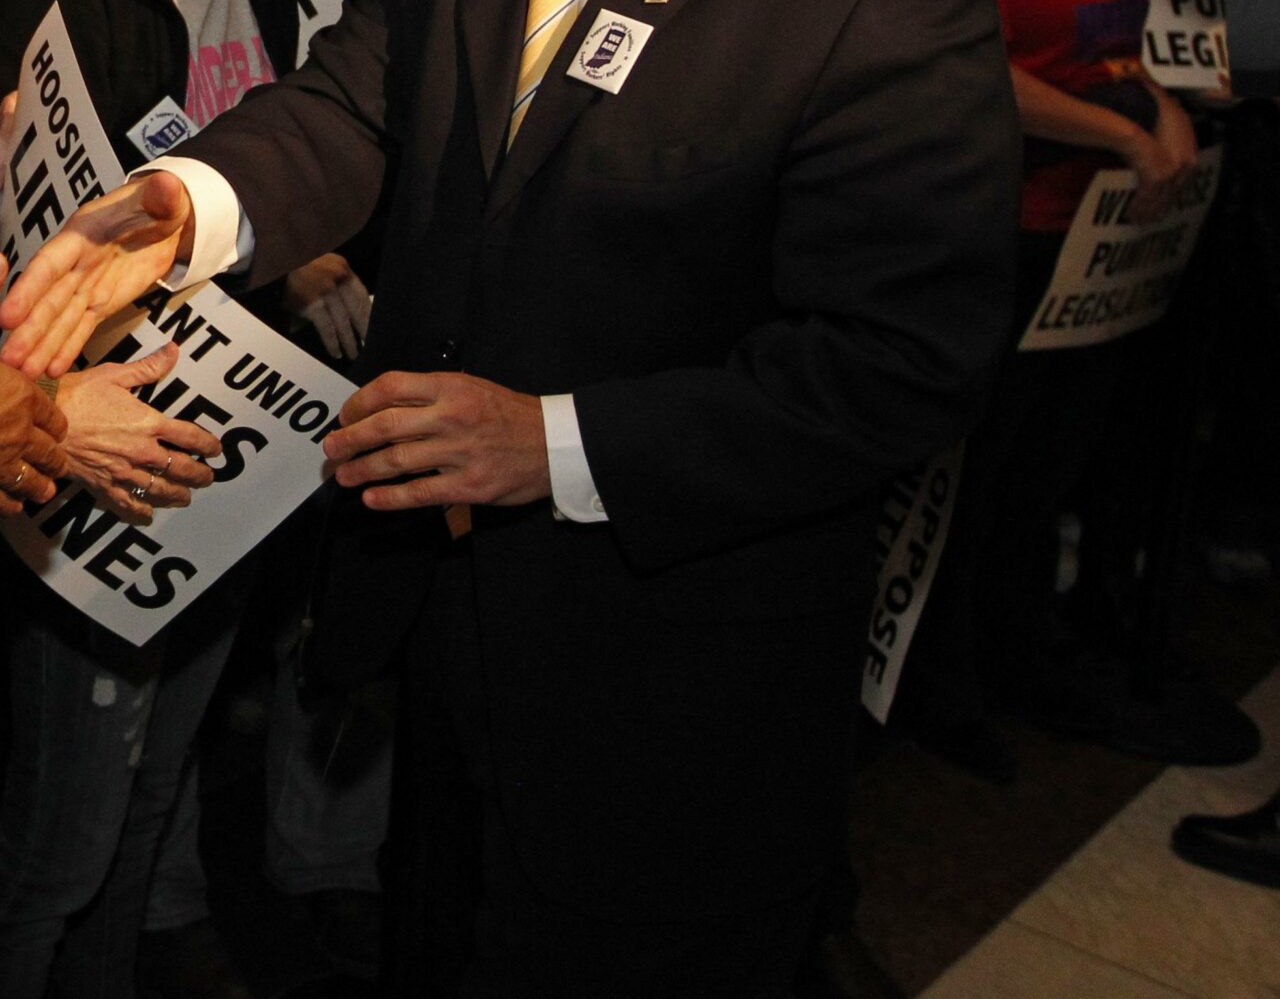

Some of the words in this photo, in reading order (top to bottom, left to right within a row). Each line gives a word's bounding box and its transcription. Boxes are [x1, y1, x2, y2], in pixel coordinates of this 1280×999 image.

[1147, 32, 1228, 67] LEGI
[9, 121, 65, 240] LIF
[132, 288, 232, 362] ANT
[22, 478, 198, 609] INES
